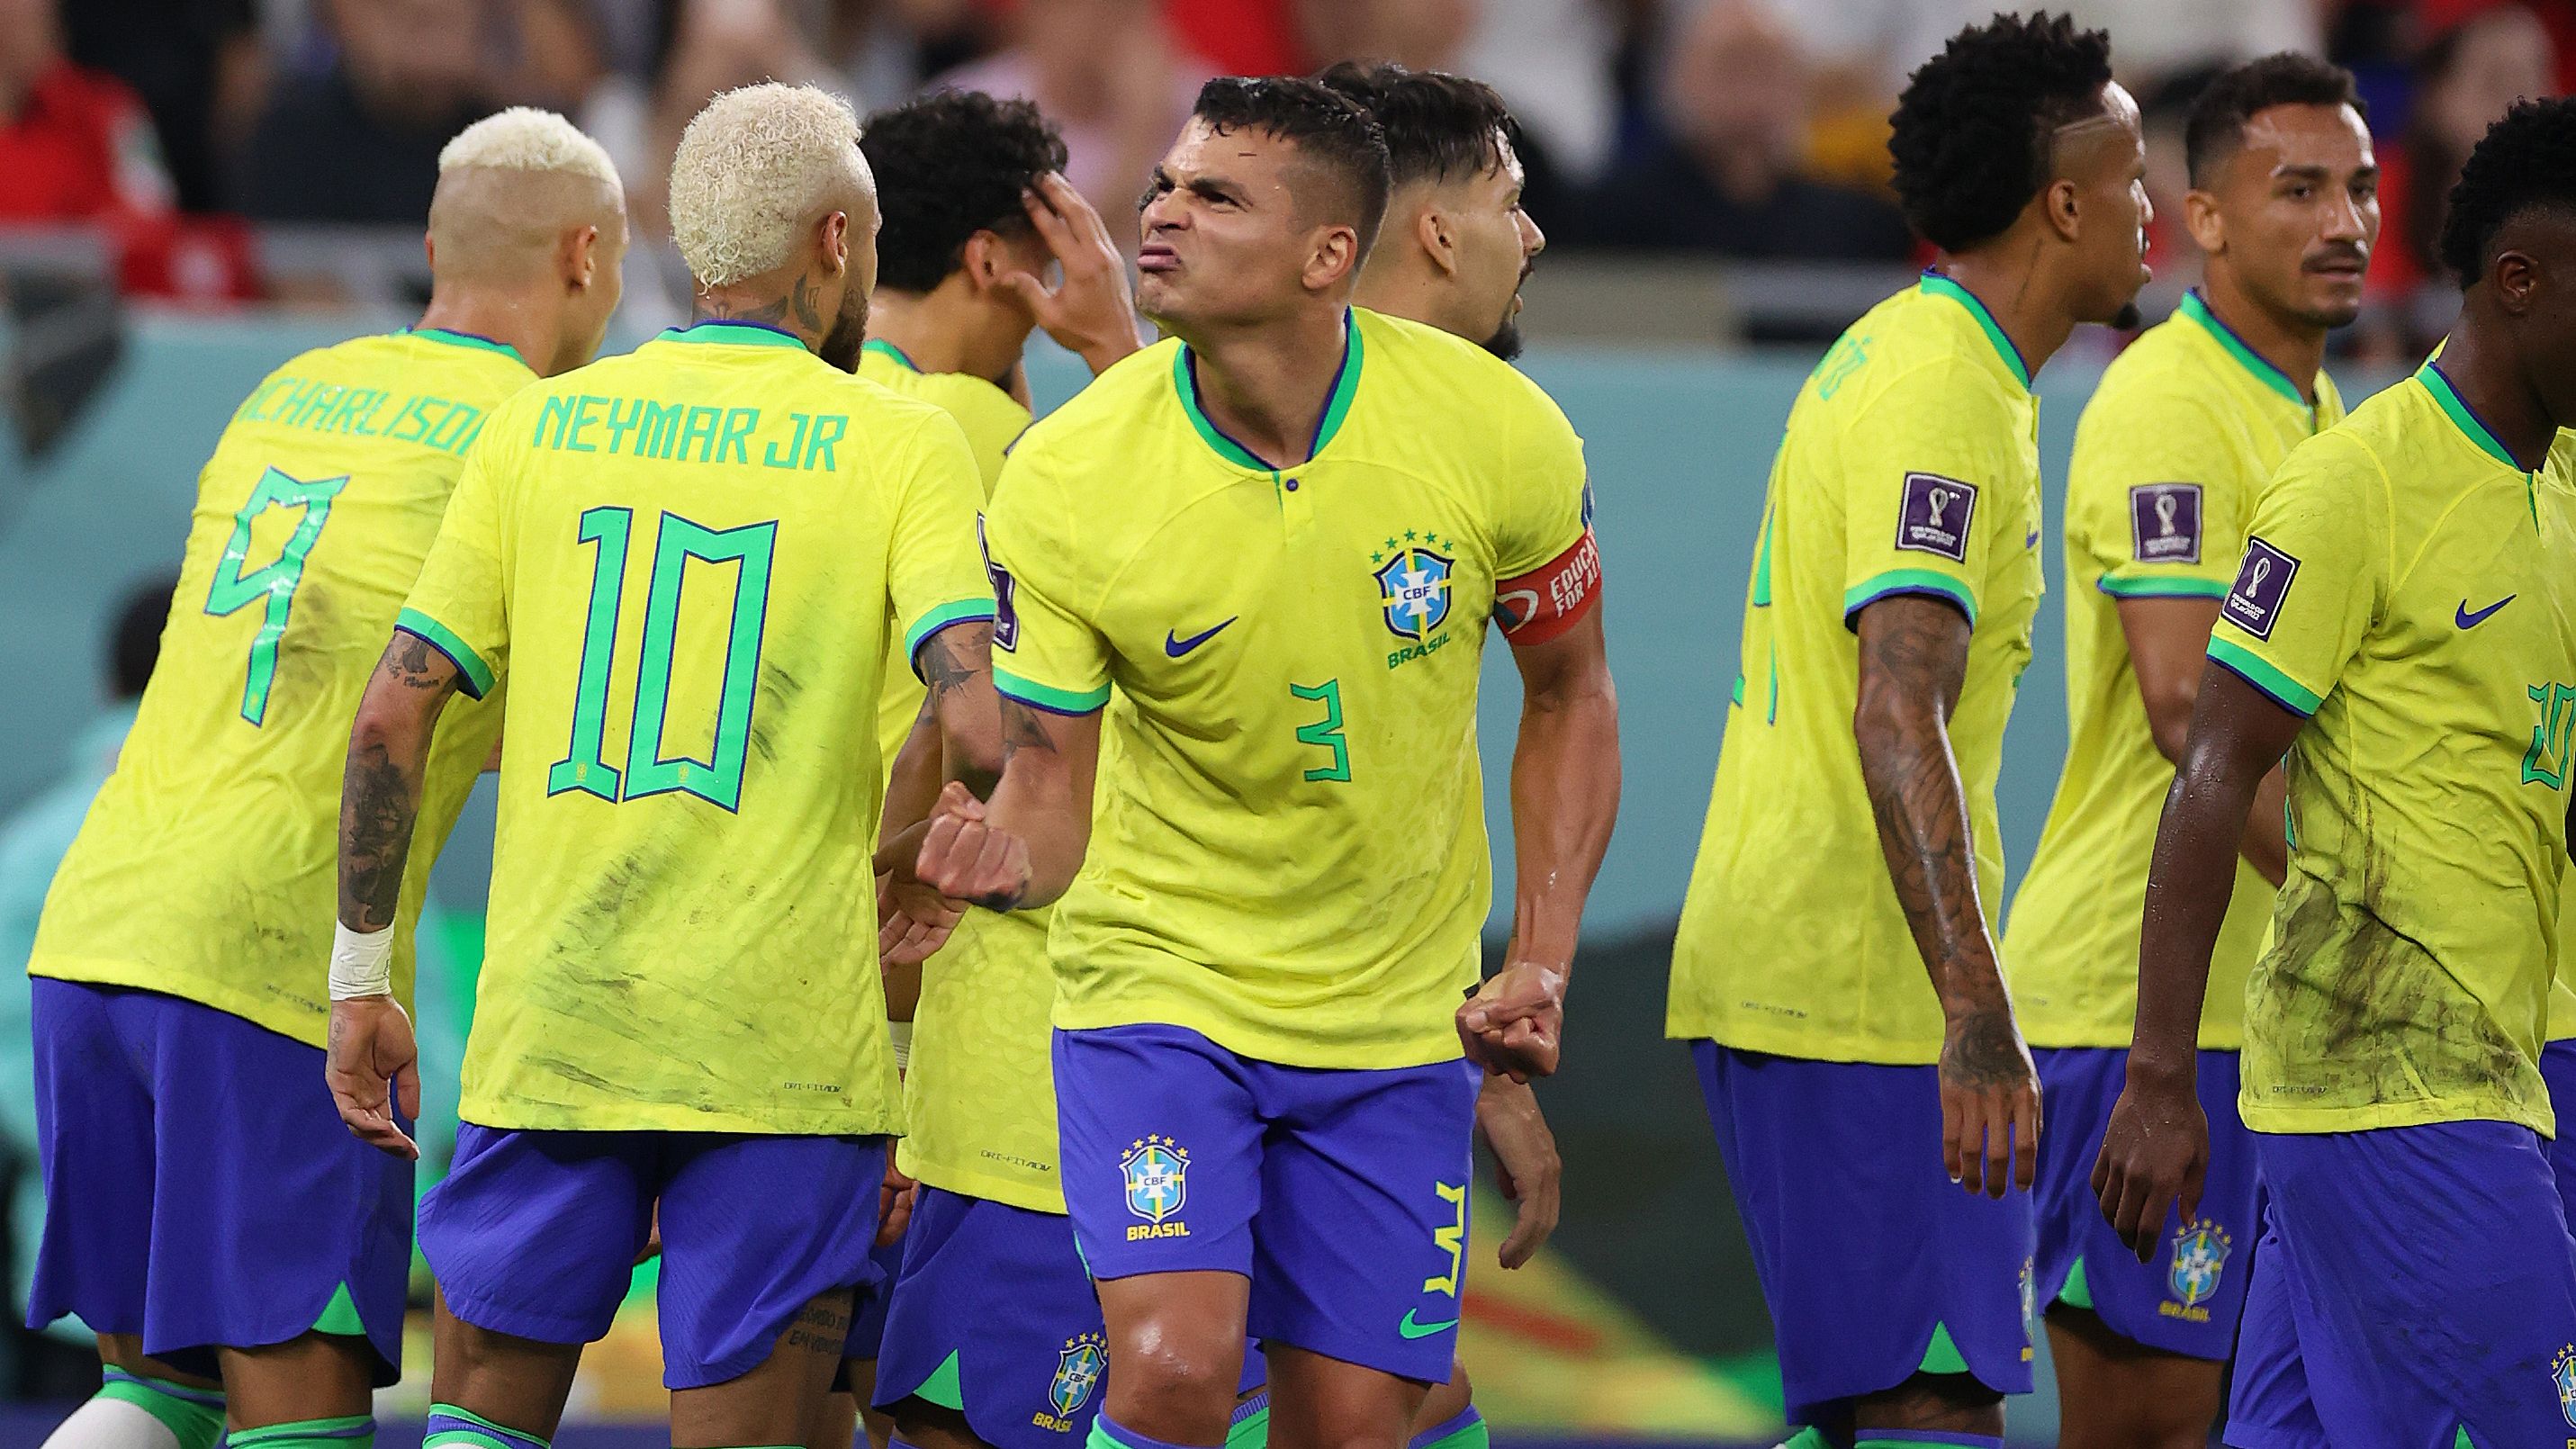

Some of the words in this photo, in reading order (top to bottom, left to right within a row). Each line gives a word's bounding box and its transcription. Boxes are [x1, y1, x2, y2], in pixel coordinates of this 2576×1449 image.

[533, 395, 761, 464] NEYMAR
[763, 412, 849, 472] JR
[204, 466, 349, 727] 9
[1403, 585, 1431, 600] CBF
[1555, 580, 1584, 618] FOR
[548, 506, 779, 814] 10
[1387, 632, 1450, 670] BRASIL
[1290, 679, 1352, 782] 3
[2521, 680, 2576, 792] 20
[1144, 1176, 1166, 1186] CBF
[1126, 1221, 1191, 1241] BRASIL
[1422, 1181, 1465, 1298] 3
[1068, 1372, 1086, 1383] CBF
